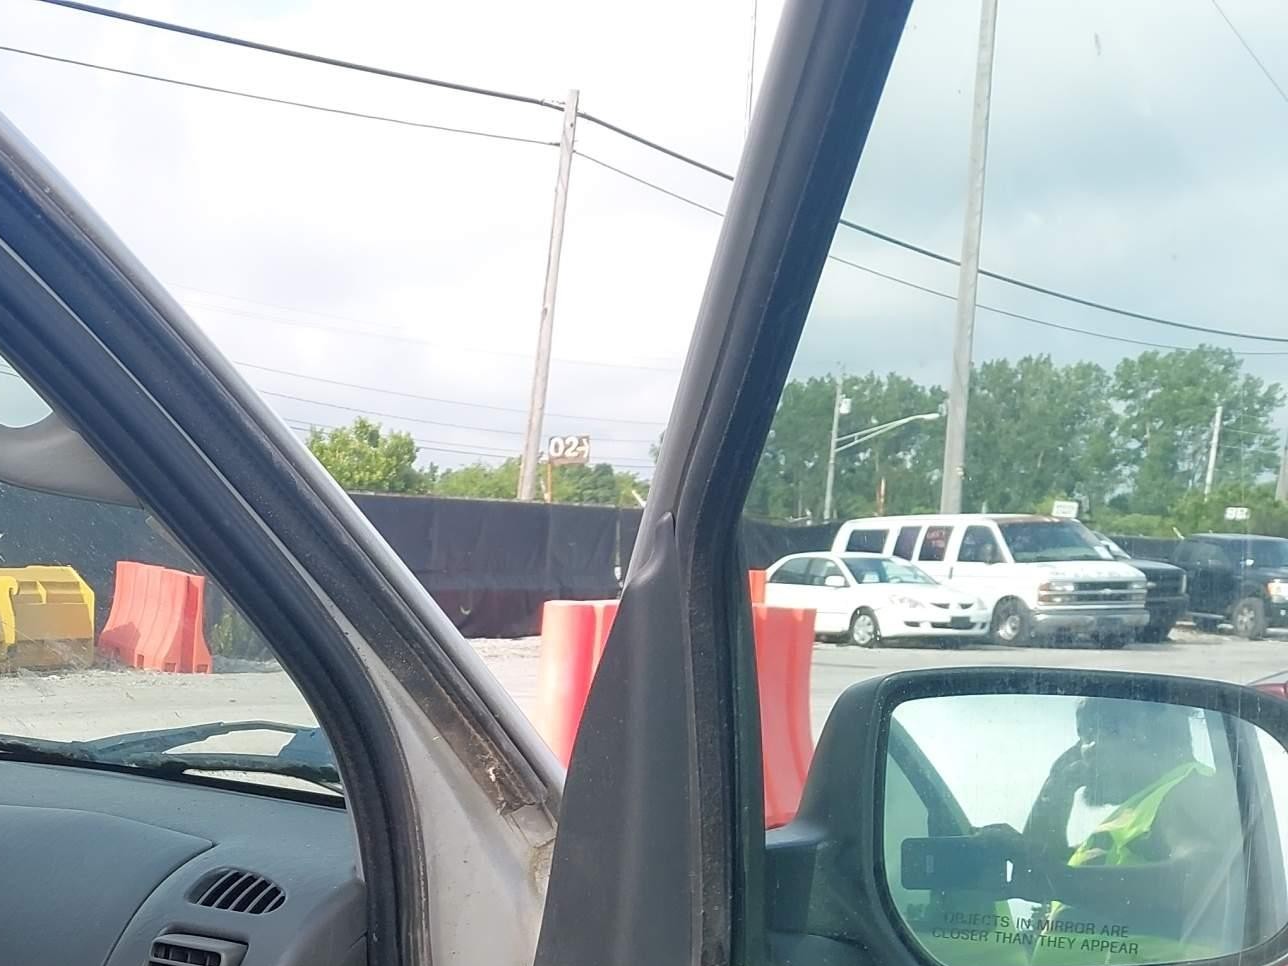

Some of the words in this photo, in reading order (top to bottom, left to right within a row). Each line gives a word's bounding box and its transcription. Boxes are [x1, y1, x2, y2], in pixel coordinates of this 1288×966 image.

[943, 911, 1010, 928] OBJECTS
[1016, 918, 1032, 930] IN
[1037, 919, 1096, 935] MIRROR
[1100, 924, 1129, 938] ARE
[932, 928, 988, 942] CLOSER
[995, 931, 1033, 945] THAN
[1040, 935, 1076, 949] THEY
[1081, 939, 1139, 955] APPEAR
